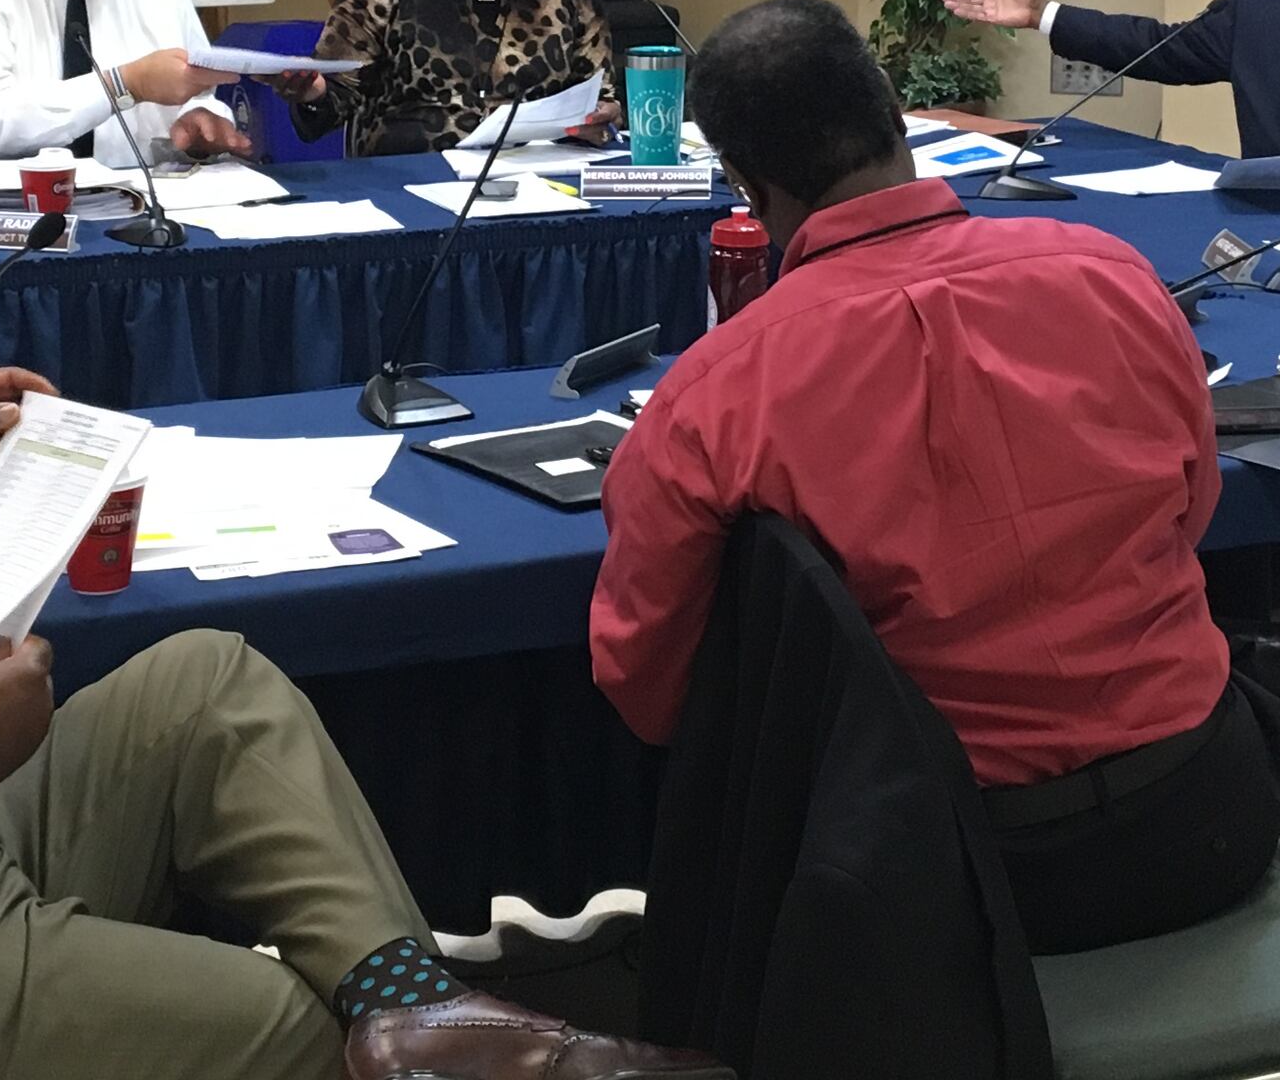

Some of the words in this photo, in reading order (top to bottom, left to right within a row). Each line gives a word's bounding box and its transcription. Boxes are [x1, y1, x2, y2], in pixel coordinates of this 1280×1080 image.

[584, 171, 626, 180] MEREDA
[628, 171, 658, 180] DAVIS
[660, 171, 709, 180] JOHNSON
[3, 219, 37, 230] RAD
